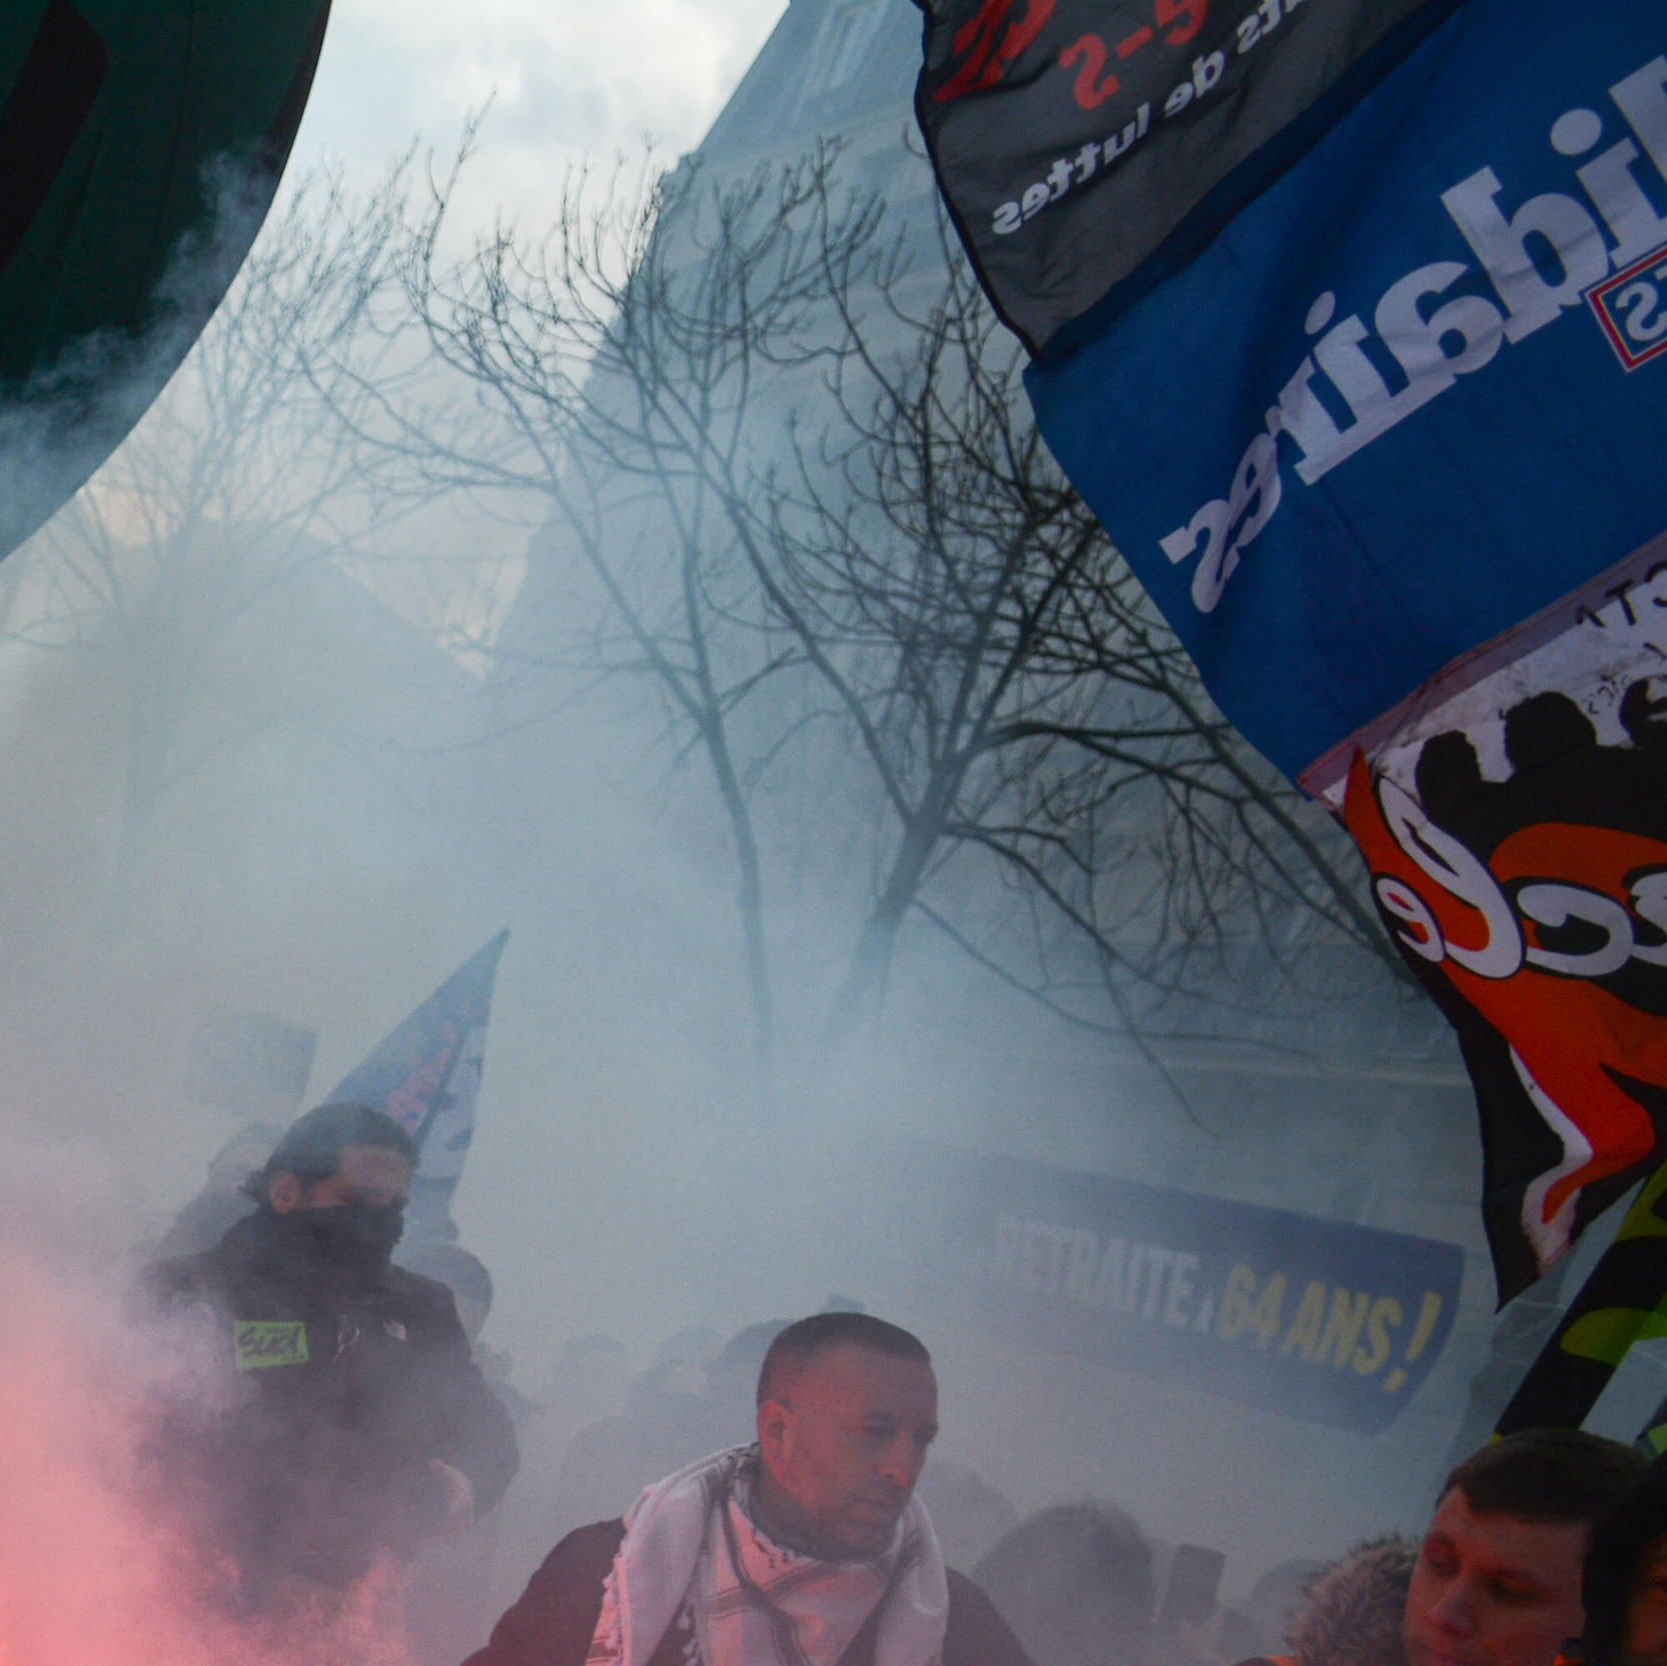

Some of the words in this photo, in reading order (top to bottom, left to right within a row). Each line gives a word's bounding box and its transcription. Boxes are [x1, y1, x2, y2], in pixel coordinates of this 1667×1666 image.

[237, 1324, 301, 1357] Sud
[992, 1216, 1202, 1328] RETRAITE
[1217, 1264, 1285, 1351] 64
[1283, 1284, 1403, 1379] ANS
